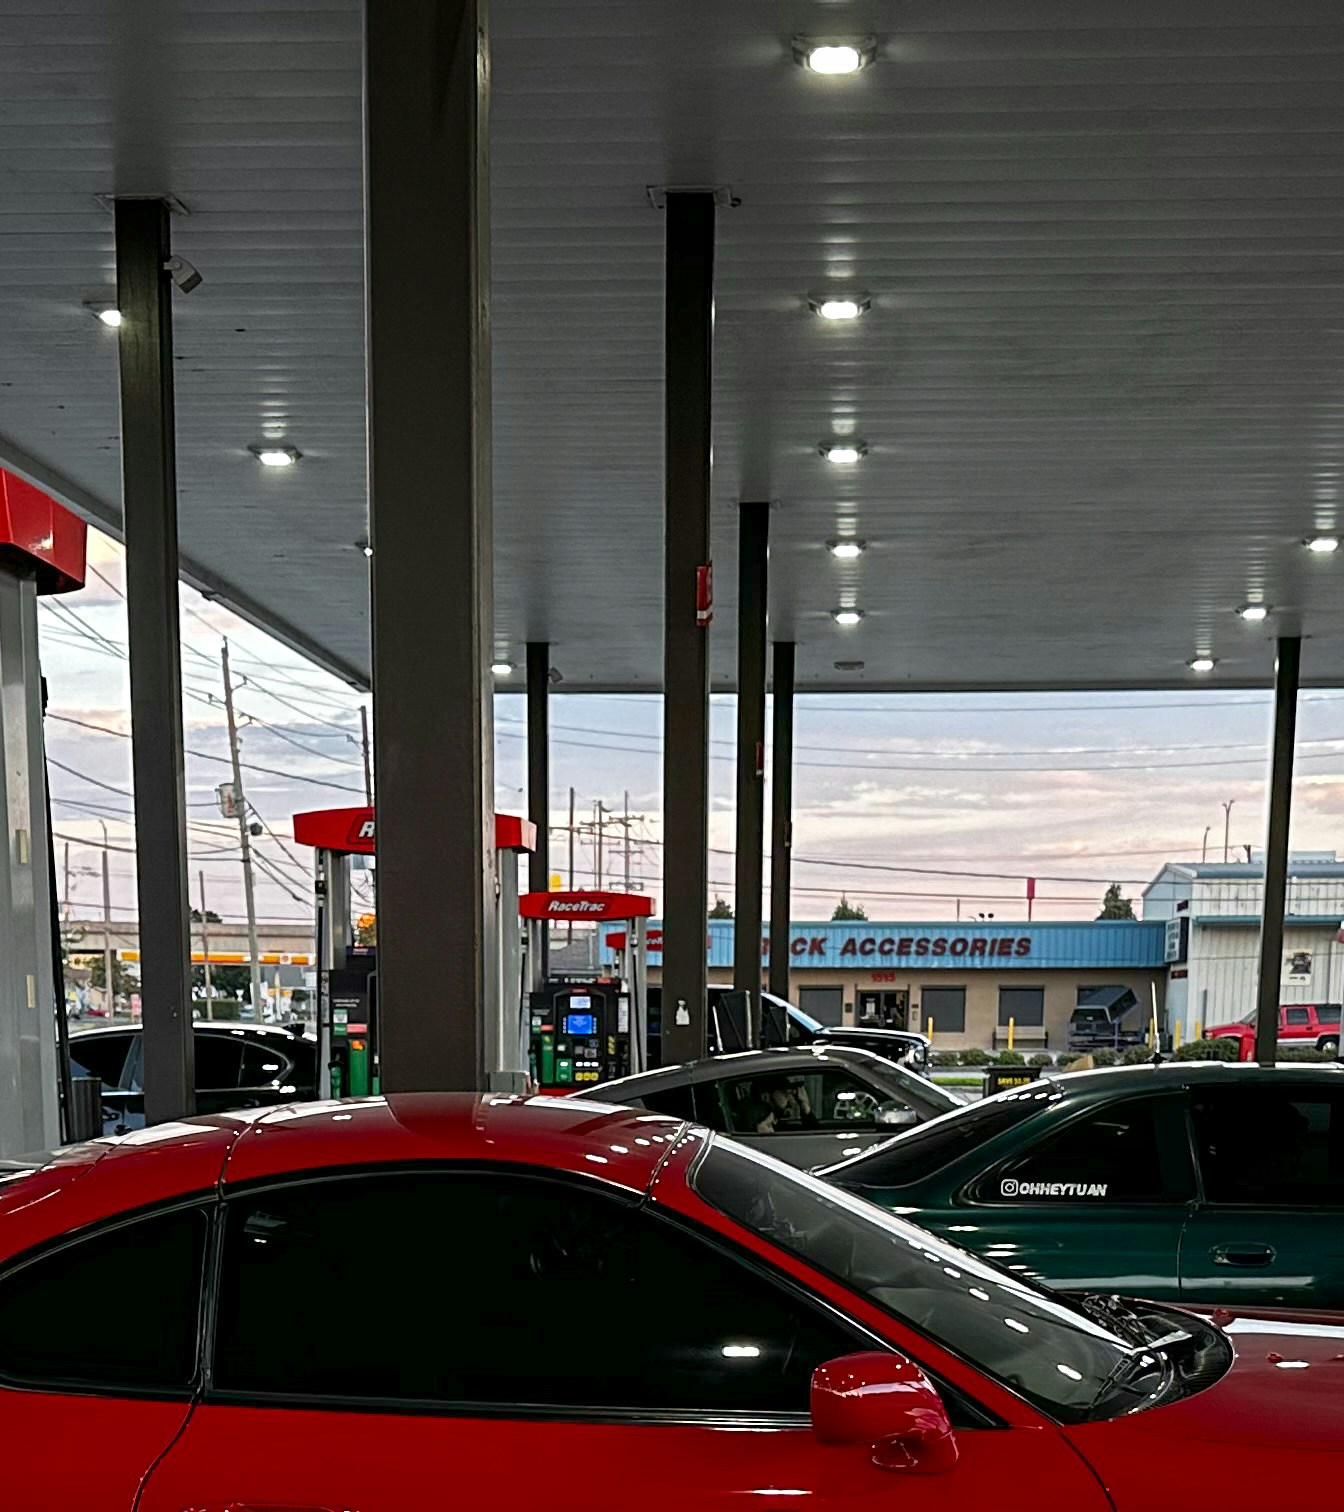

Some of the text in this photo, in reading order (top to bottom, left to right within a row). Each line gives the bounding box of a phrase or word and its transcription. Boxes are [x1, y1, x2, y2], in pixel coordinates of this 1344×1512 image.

[548, 900, 606, 912] RaceTrac
[839, 937, 1032, 957] ACCESSORIES
[1019, 1182, 1108, 1197] OHHEYTUAN
